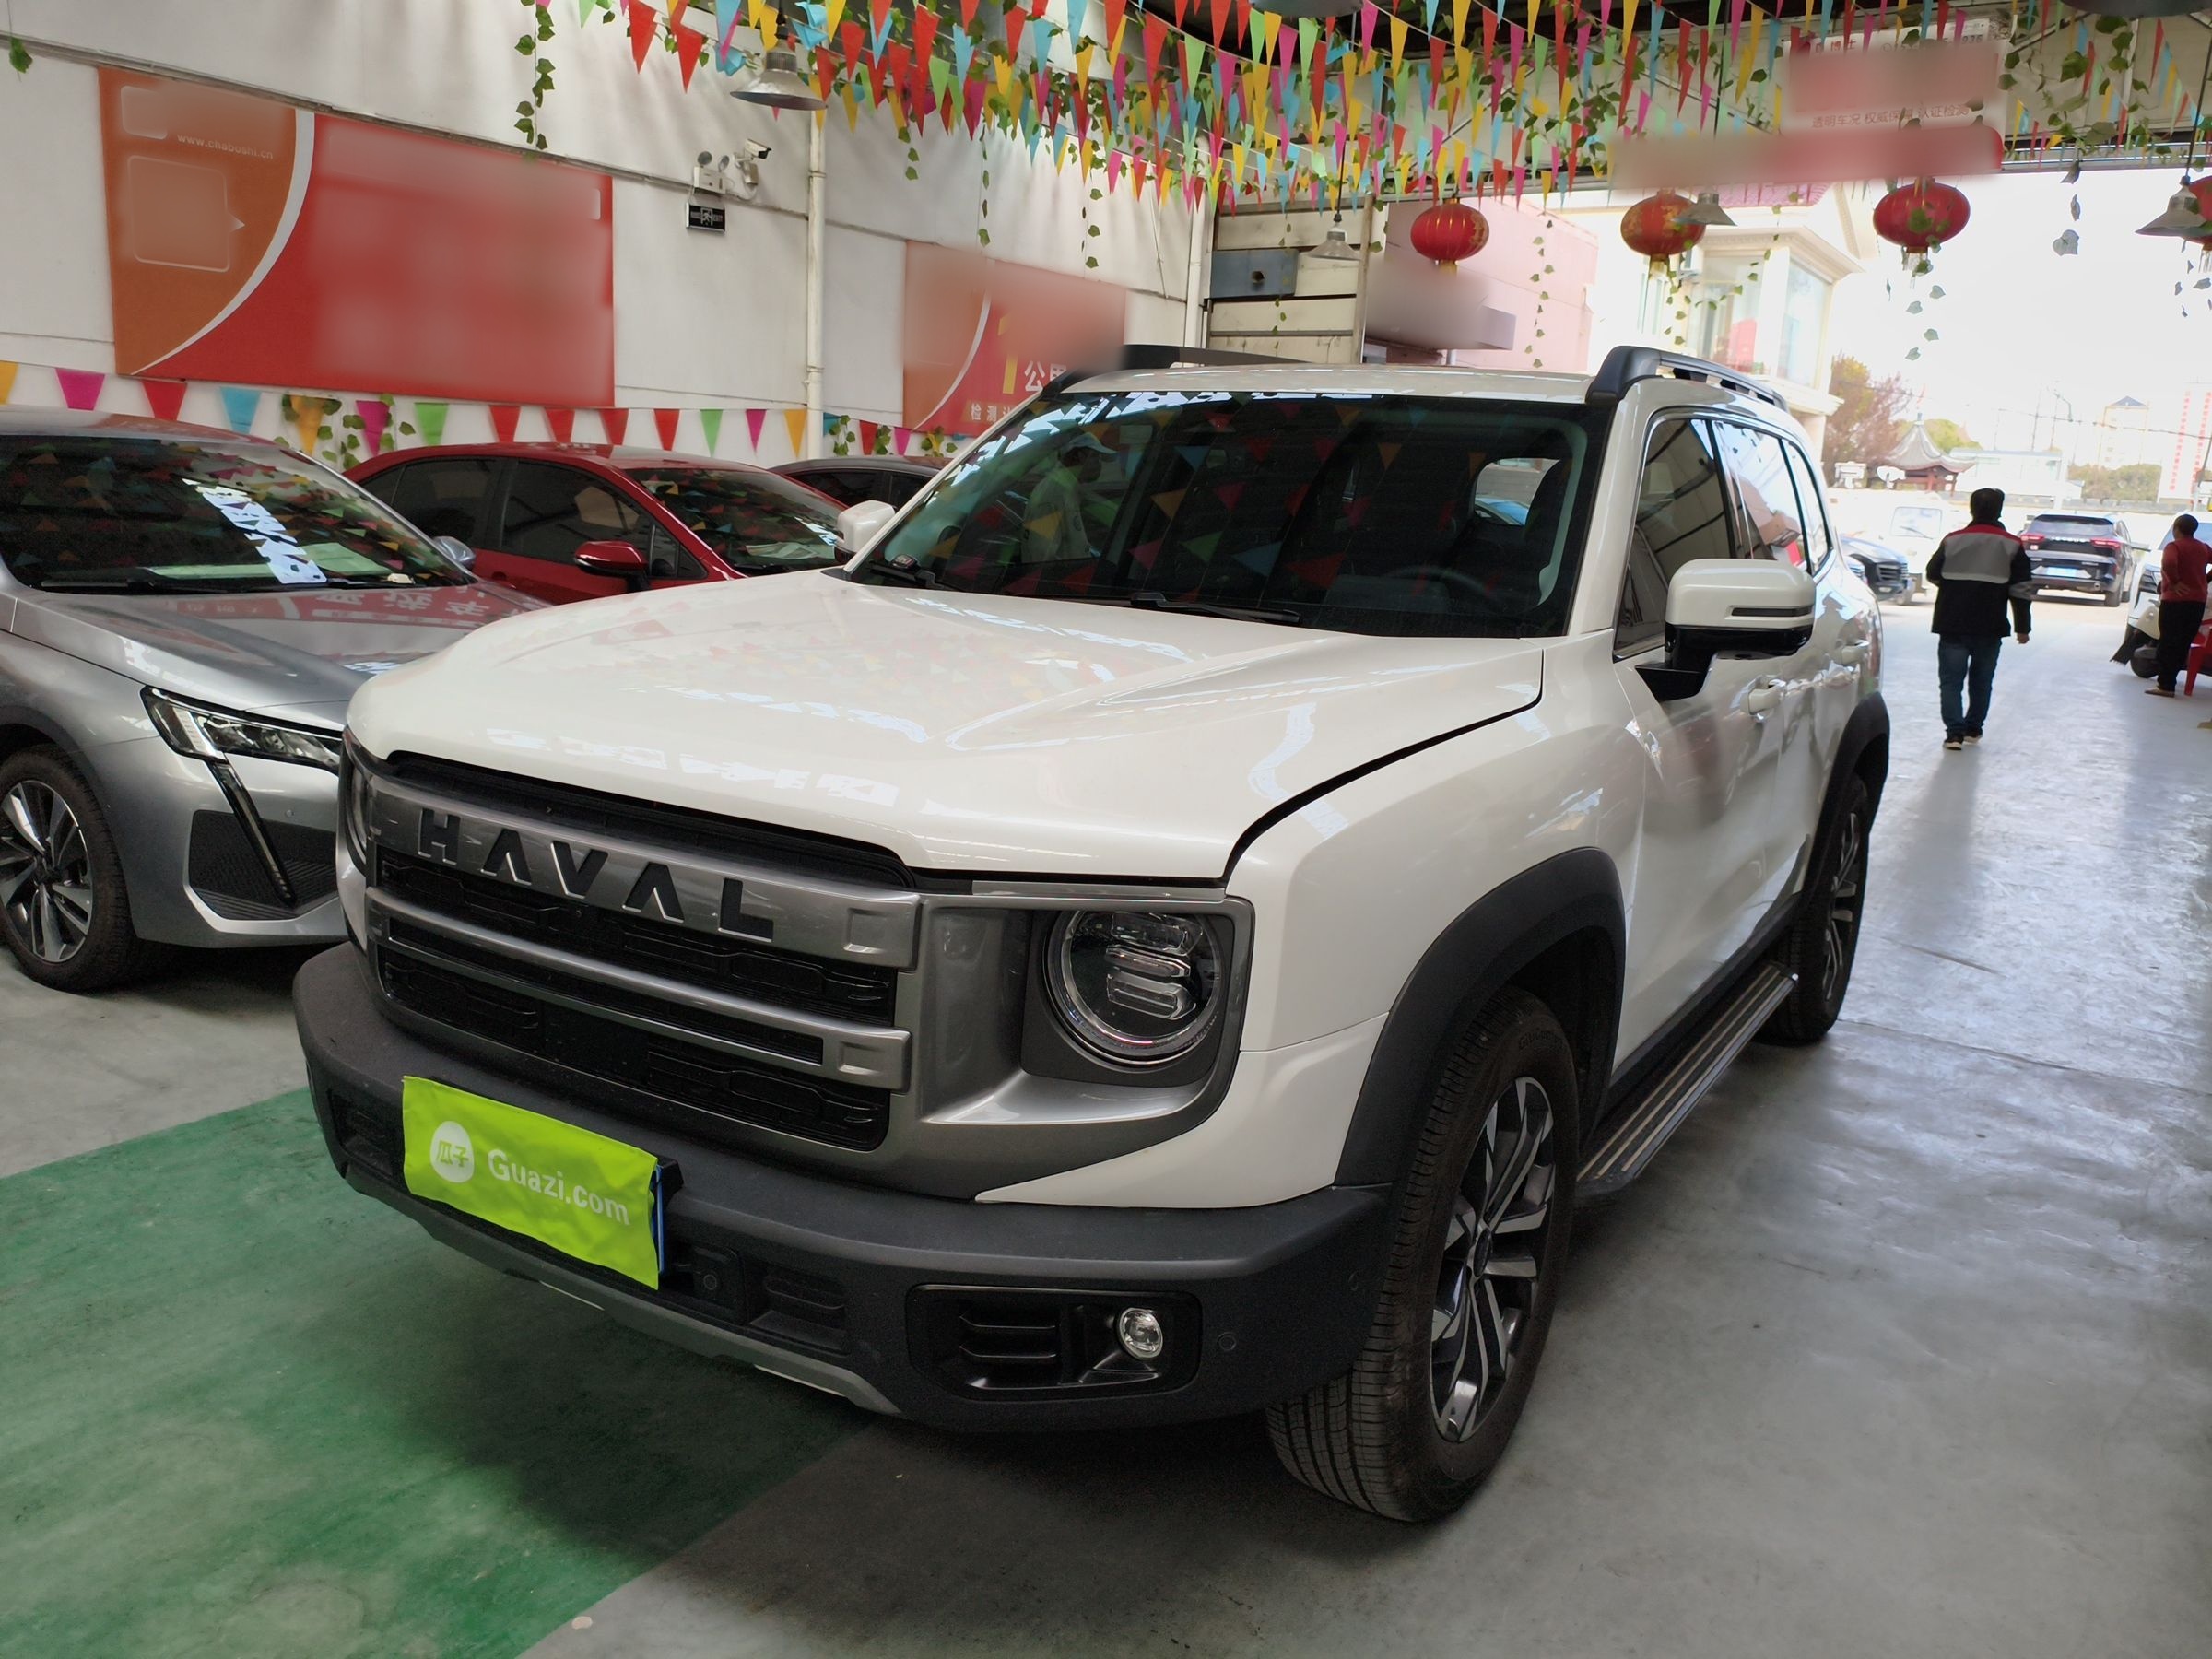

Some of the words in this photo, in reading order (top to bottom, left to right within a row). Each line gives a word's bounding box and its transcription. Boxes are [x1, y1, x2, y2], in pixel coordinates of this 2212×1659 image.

[176, 134, 274, 159] www.chaboshi.cn
[418, 808, 773, 943] HAVAL
[437, 1140, 470, 1168] 瓜子
[488, 1148, 630, 1226] Guazi.com
